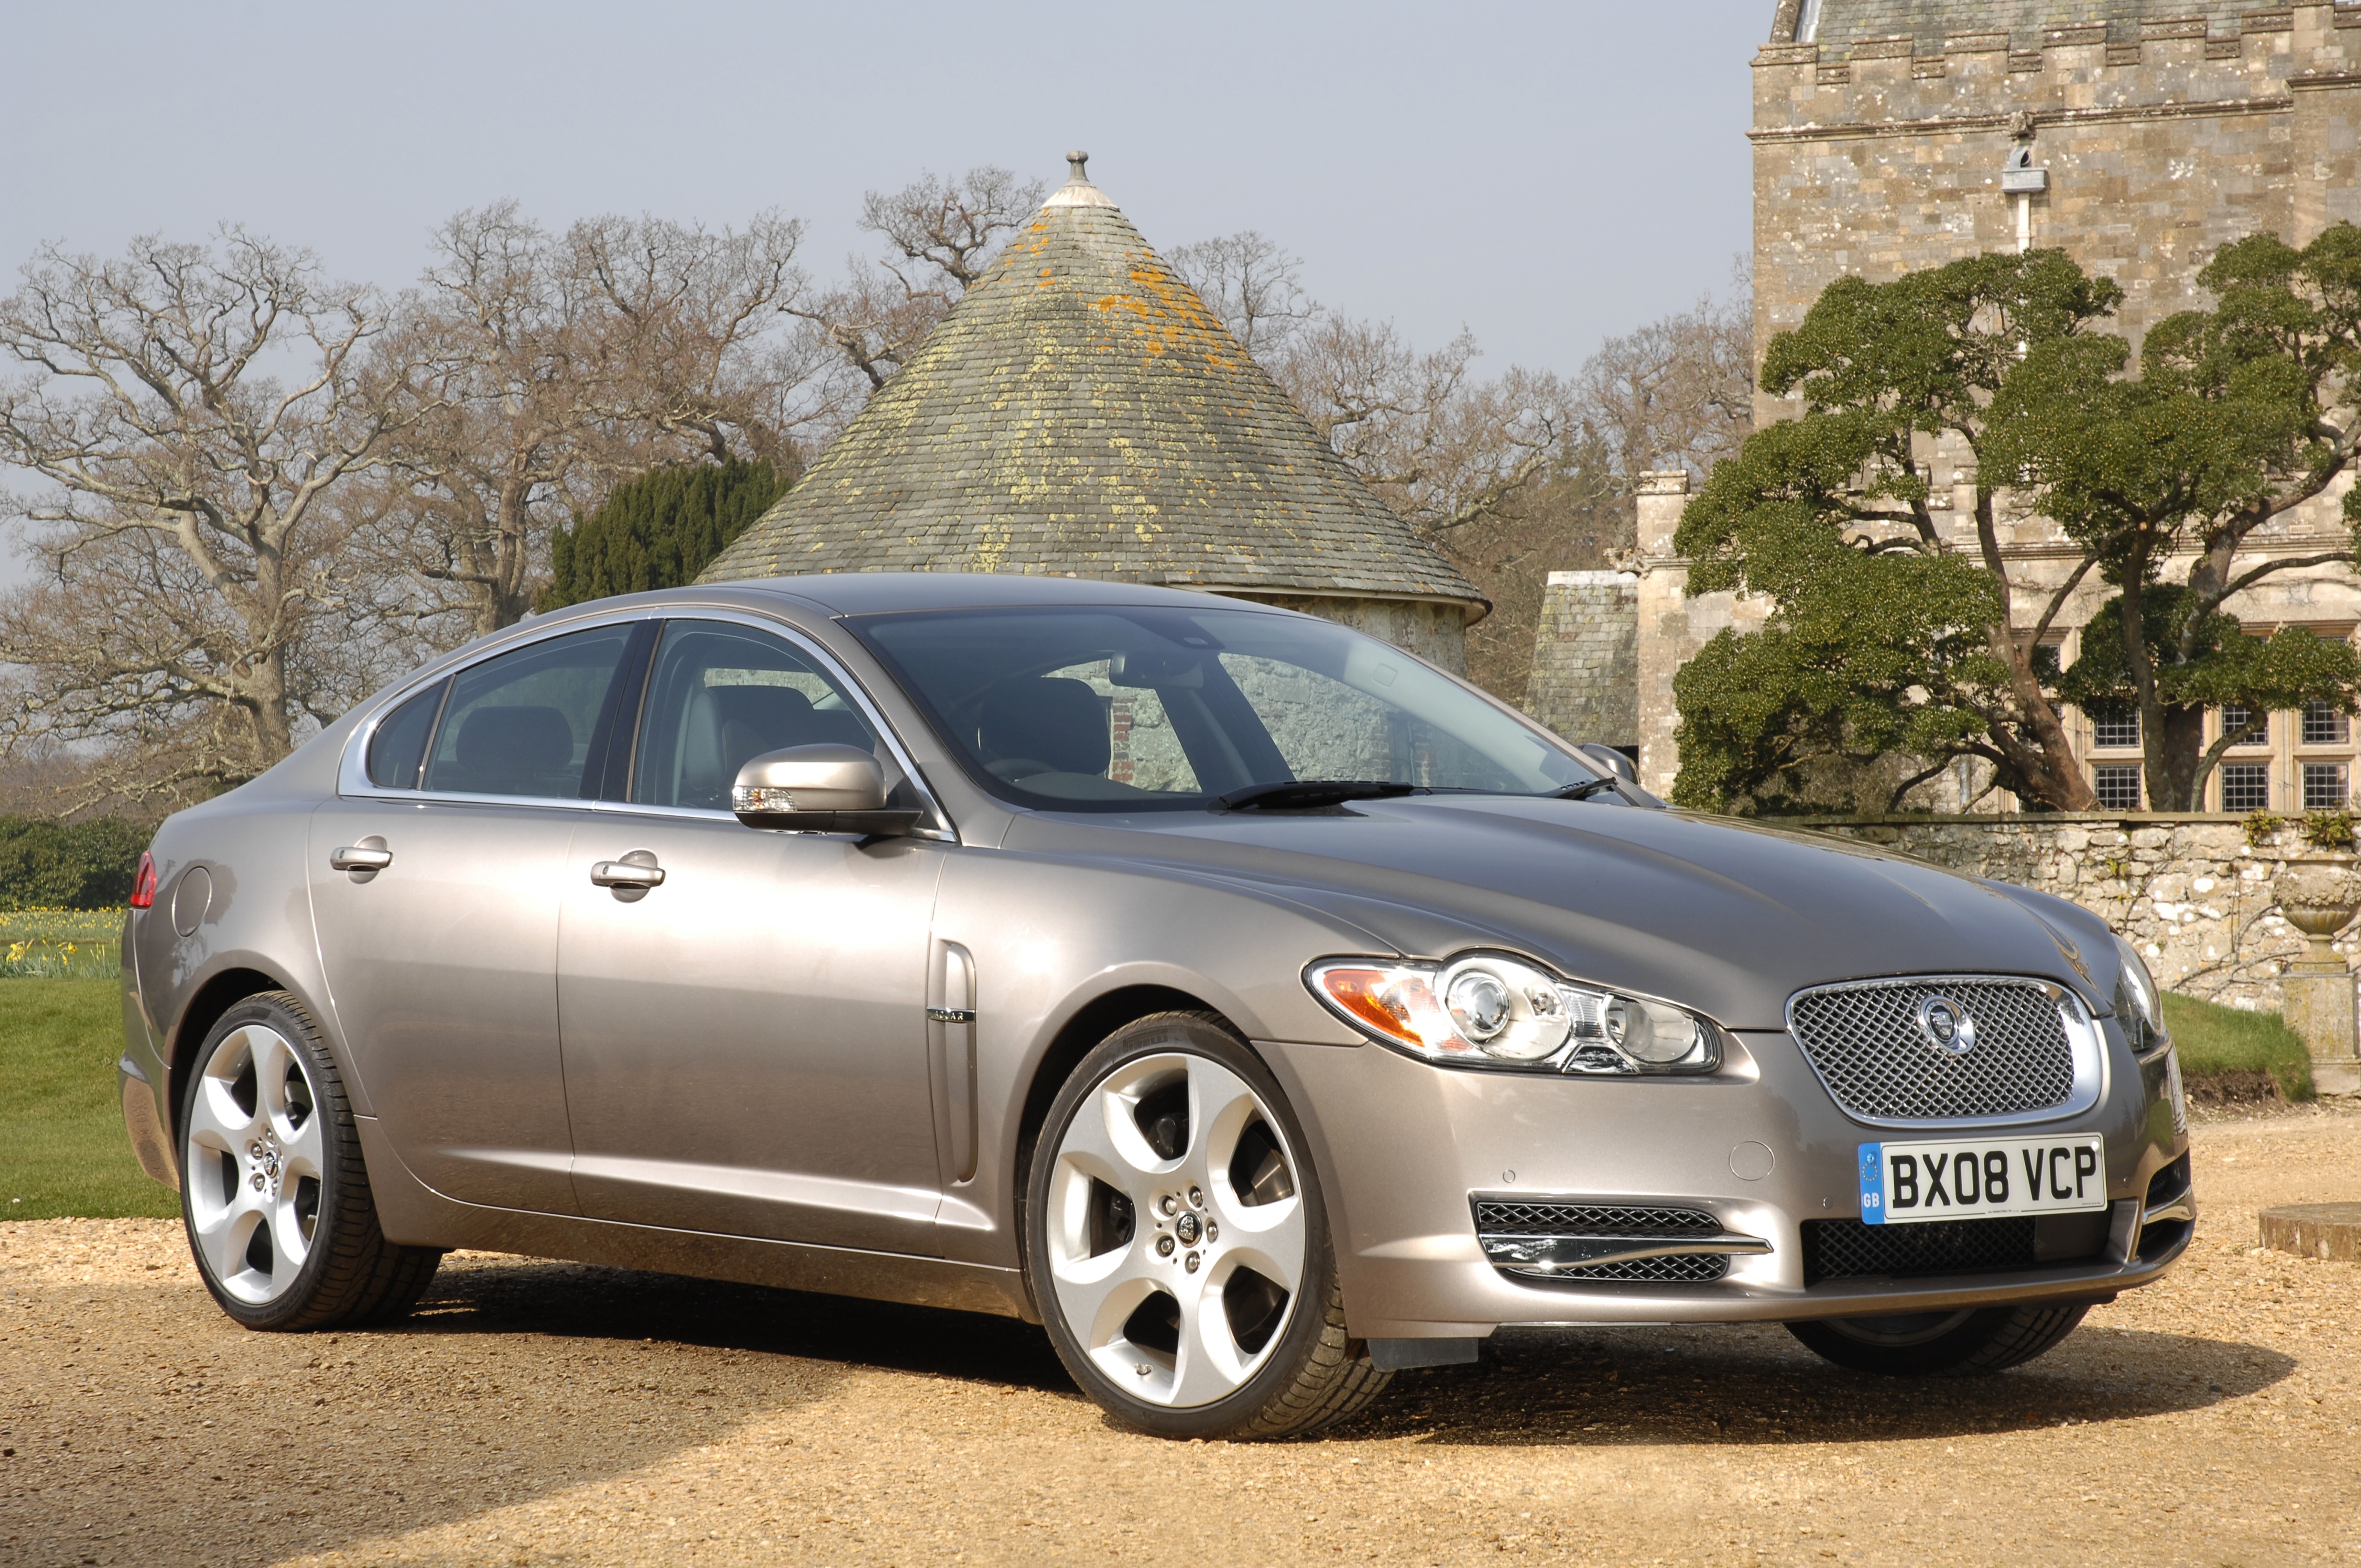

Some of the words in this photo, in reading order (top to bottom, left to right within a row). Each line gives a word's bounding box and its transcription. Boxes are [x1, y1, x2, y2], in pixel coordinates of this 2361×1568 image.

[1890, 1151, 2009, 1208] BX08
[2022, 1146, 2096, 1201] VCP
[1864, 1192, 1879, 1208] GB
